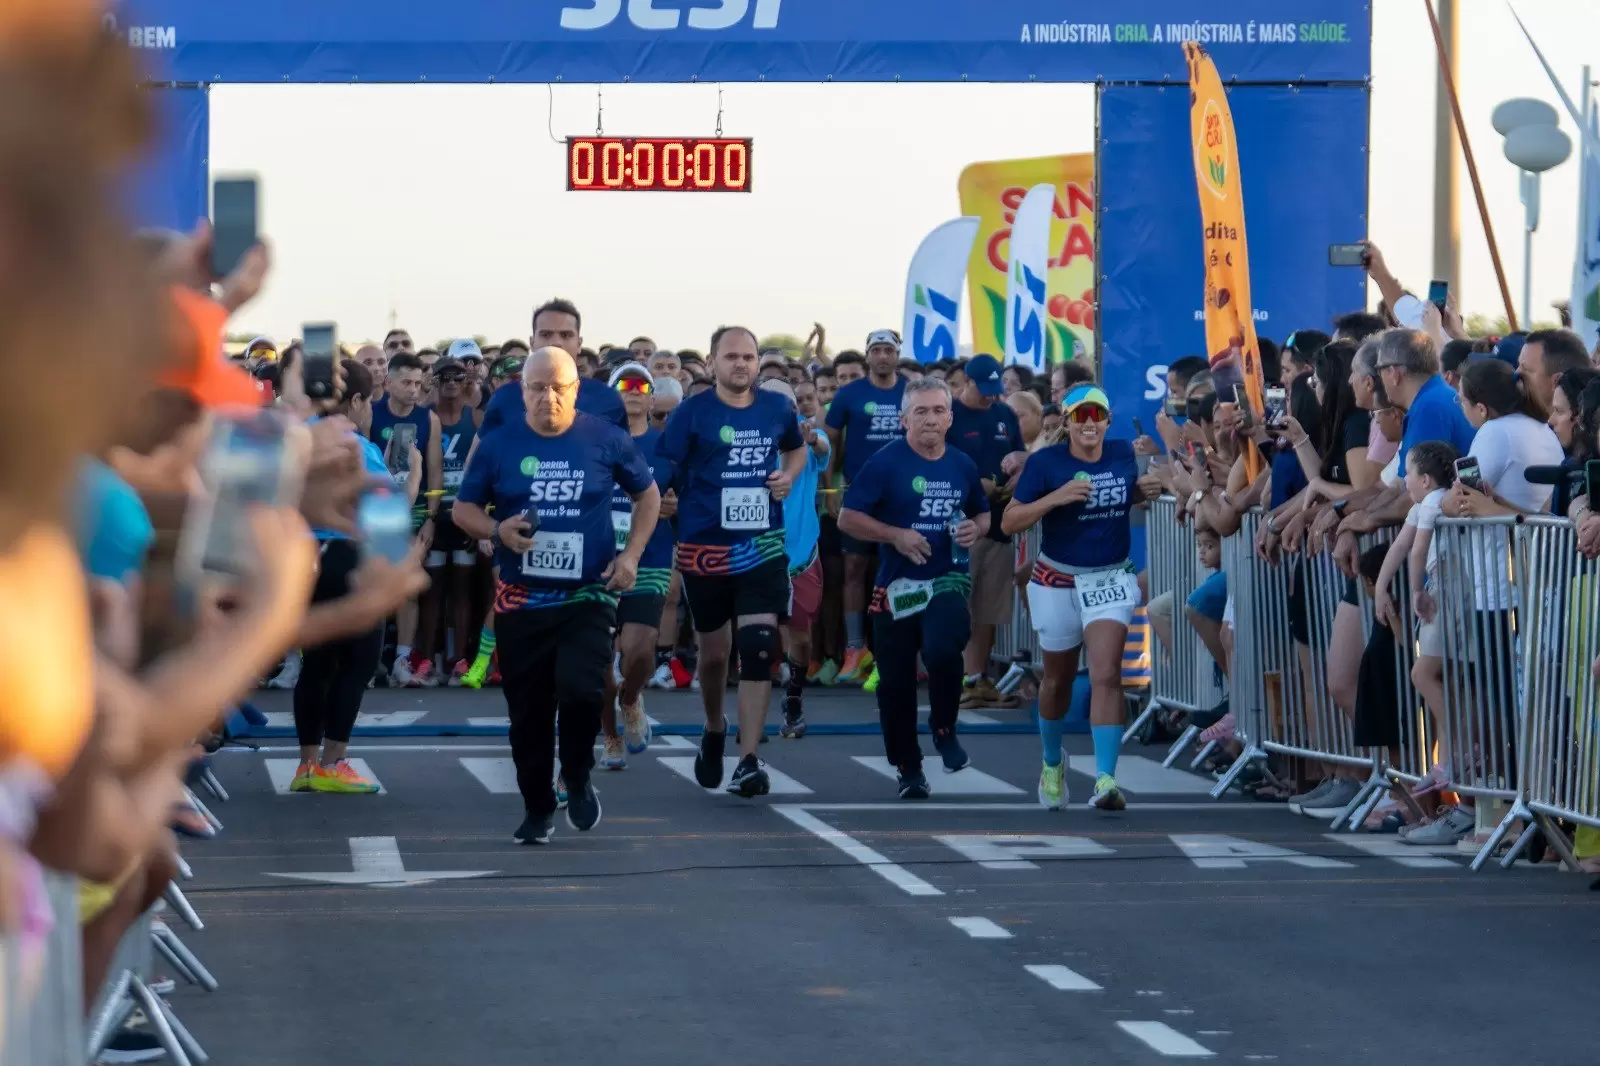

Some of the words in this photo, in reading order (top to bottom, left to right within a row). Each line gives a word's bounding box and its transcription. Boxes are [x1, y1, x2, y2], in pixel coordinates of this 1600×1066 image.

[128, 26, 176, 48] BEM
[1021, 24, 1031, 42] A
[1035, 20, 1112, 42] INDÚSTRIA
[1153, 24, 1163, 42] A
[1167, 20, 1243, 43] INDÚSTRIA
[1247, 20, 1256, 42] É
[1259, 24, 1296, 42] MAIS
[1299, 20, 1351, 43] SAÚDE.
[572, 142, 746, 187] 00:00:00
[763, 437, 772, 445] DO
[533, 470, 571, 479] NACIONAL
[572, 470, 585, 479] DO
[535, 461, 569, 470] CORRIDA
[529, 480, 584, 502] SESI
[1085, 486, 1127, 509] SESI
[546, 509, 558, 517] FAZ
[566, 509, 581, 517] BEM
[729, 505, 764, 522] 5000
[532, 551, 574, 570] 5007
[1086, 585, 1125, 606] 5003
